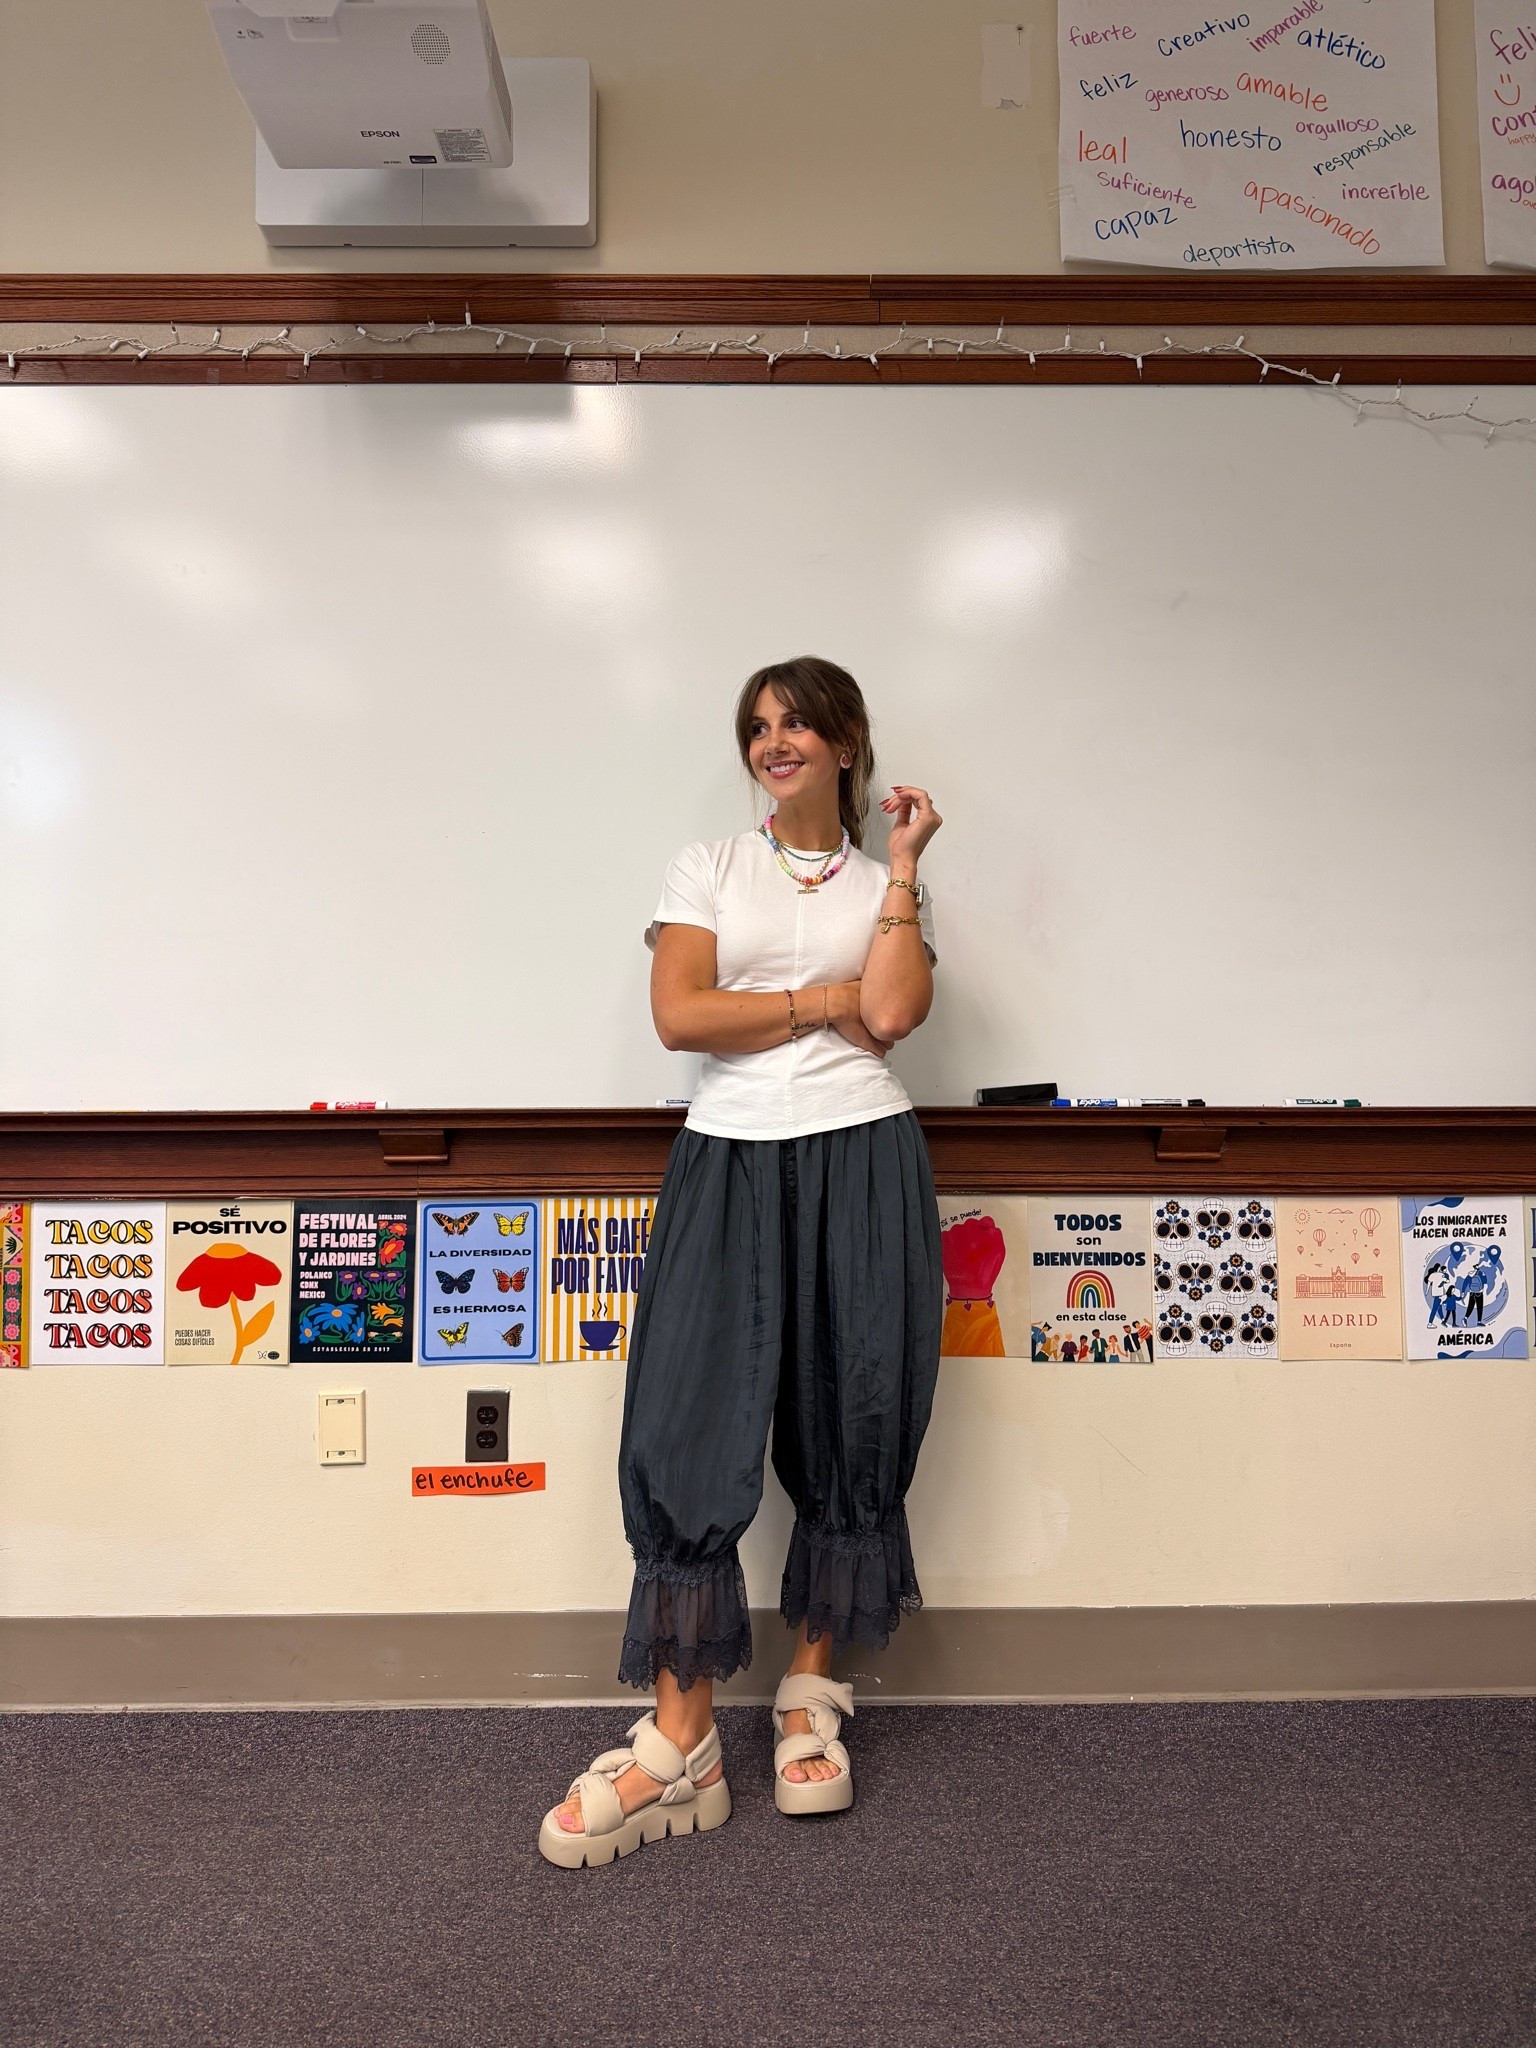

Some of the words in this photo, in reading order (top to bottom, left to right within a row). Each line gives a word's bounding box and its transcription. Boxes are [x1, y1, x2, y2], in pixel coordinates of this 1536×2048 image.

[1069, 24, 1137, 47] fuerte
[1158, 13, 1250, 57] creativo
[1246, 0, 1323, 52] imparable
[1297, 28, 1386, 70] atlético
[1490, 26, 1536, 65] feli
[1080, 71, 1139, 101] feliz
[1237, 72, 1328, 112] amable
[1145, 85, 1229, 112] generoso
[1295, 117, 1379, 140] orgulloso
[1491, 105, 1536, 136] con
[1078, 130, 1127, 163] leal
[1180, 119, 1282, 151] honesto
[1312, 122, 1417, 176] responsable
[1097, 171, 1197, 210] suficiente
[1342, 183, 1430, 201] increíble
[1491, 174, 1536, 203] ago
[1095, 206, 1178, 241] capaz
[1244, 181, 1381, 256] apasionado
[1183, 235, 1296, 267] deportista
[1079, 1099, 1100, 1107] EXPO
[219, 1205, 241, 1217] SÉ
[300, 1213, 378, 1230] FESTIVAL
[1054, 1214, 1122, 1231] TODOS
[1415, 1216, 1434, 1227] LOS
[1437, 1214, 1508, 1226] INMIGRANTES
[45, 1219, 154, 1245] TACOS
[172, 1220, 287, 1235] POSITIVO
[557, 1209, 600, 1255] MÁS
[605, 1208, 651, 1254] CAFÉ
[1412, 1227, 1449, 1239] HACEN
[1452, 1226, 1496, 1238] GRANDE
[1498, 1226, 1507, 1237] A
[299, 1232, 318, 1248] DE
[320, 1232, 377, 1248] FLORES
[1076, 1235, 1101, 1246] son
[299, 1252, 308, 1267] Y
[310, 1252, 377, 1267] JARDINES
[429, 1250, 448, 1258] LA
[449, 1248, 532, 1258] DIVERSIDAD
[1033, 1251, 1146, 1267] BIENVENIDOS
[44, 1254, 153, 1279] TACOS
[300, 1271, 333, 1279] POLANCO
[551, 1257, 590, 1295] POR
[596, 1256, 646, 1294] FAVO
[300, 1281, 319, 1289] CDMX
[44, 1288, 153, 1314] TACOS
[433, 1305, 452, 1315] ES
[453, 1304, 527, 1314] HERMOSA
[1056, 1313, 1070, 1321] en
[1072, 1311, 1096, 1321] esta
[1099, 1310, 1127, 1321] clase
[1302, 1313, 1378, 1327] MADRID
[43, 1323, 153, 1349] TACOS
[175, 1329, 193, 1337] PUEDES
[195, 1329, 211, 1337] HACER
[175, 1338, 191, 1346] COSAS
[192, 1336, 215, 1346] DIFÍCILES
[1437, 1330, 1494, 1346] AMÉRICA
[415, 1472, 434, 1490] el
[440, 1468, 533, 1489] enchufe
